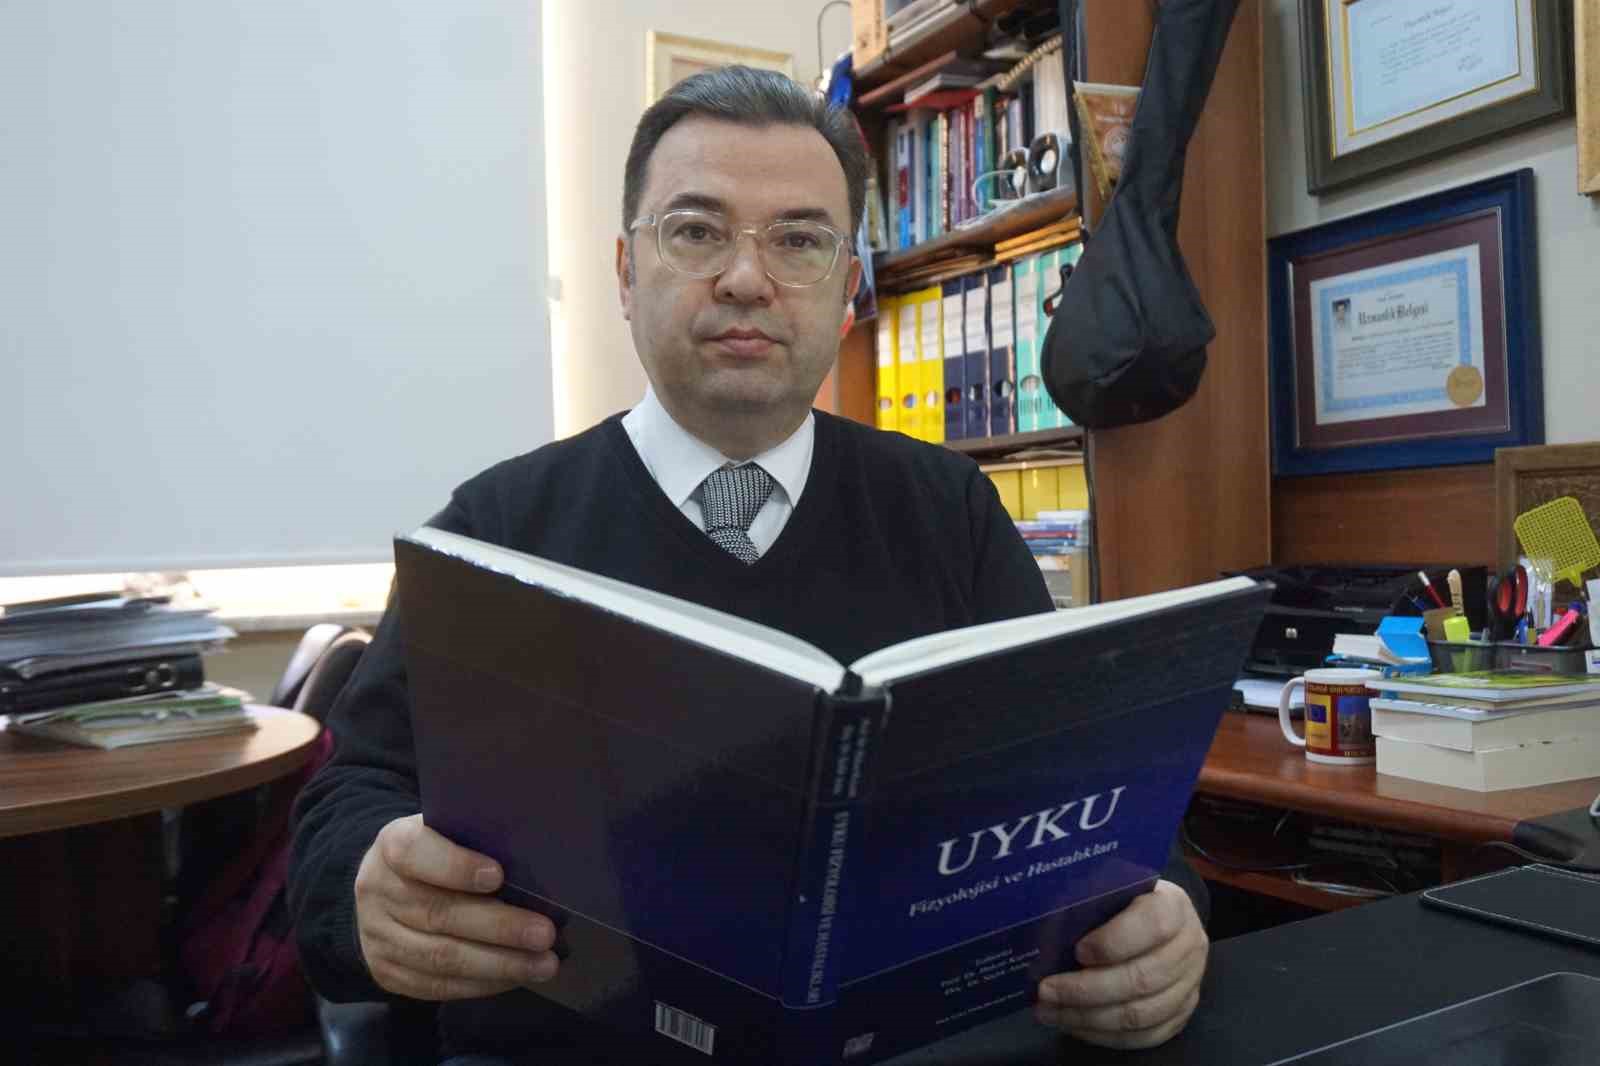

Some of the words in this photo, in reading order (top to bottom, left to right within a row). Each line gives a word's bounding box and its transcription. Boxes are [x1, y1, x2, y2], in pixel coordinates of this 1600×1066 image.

[937, 785, 1126, 876] UYKU
[909, 875, 999, 917] Fizyolojisi
[1004, 871, 1023, 883] ve
